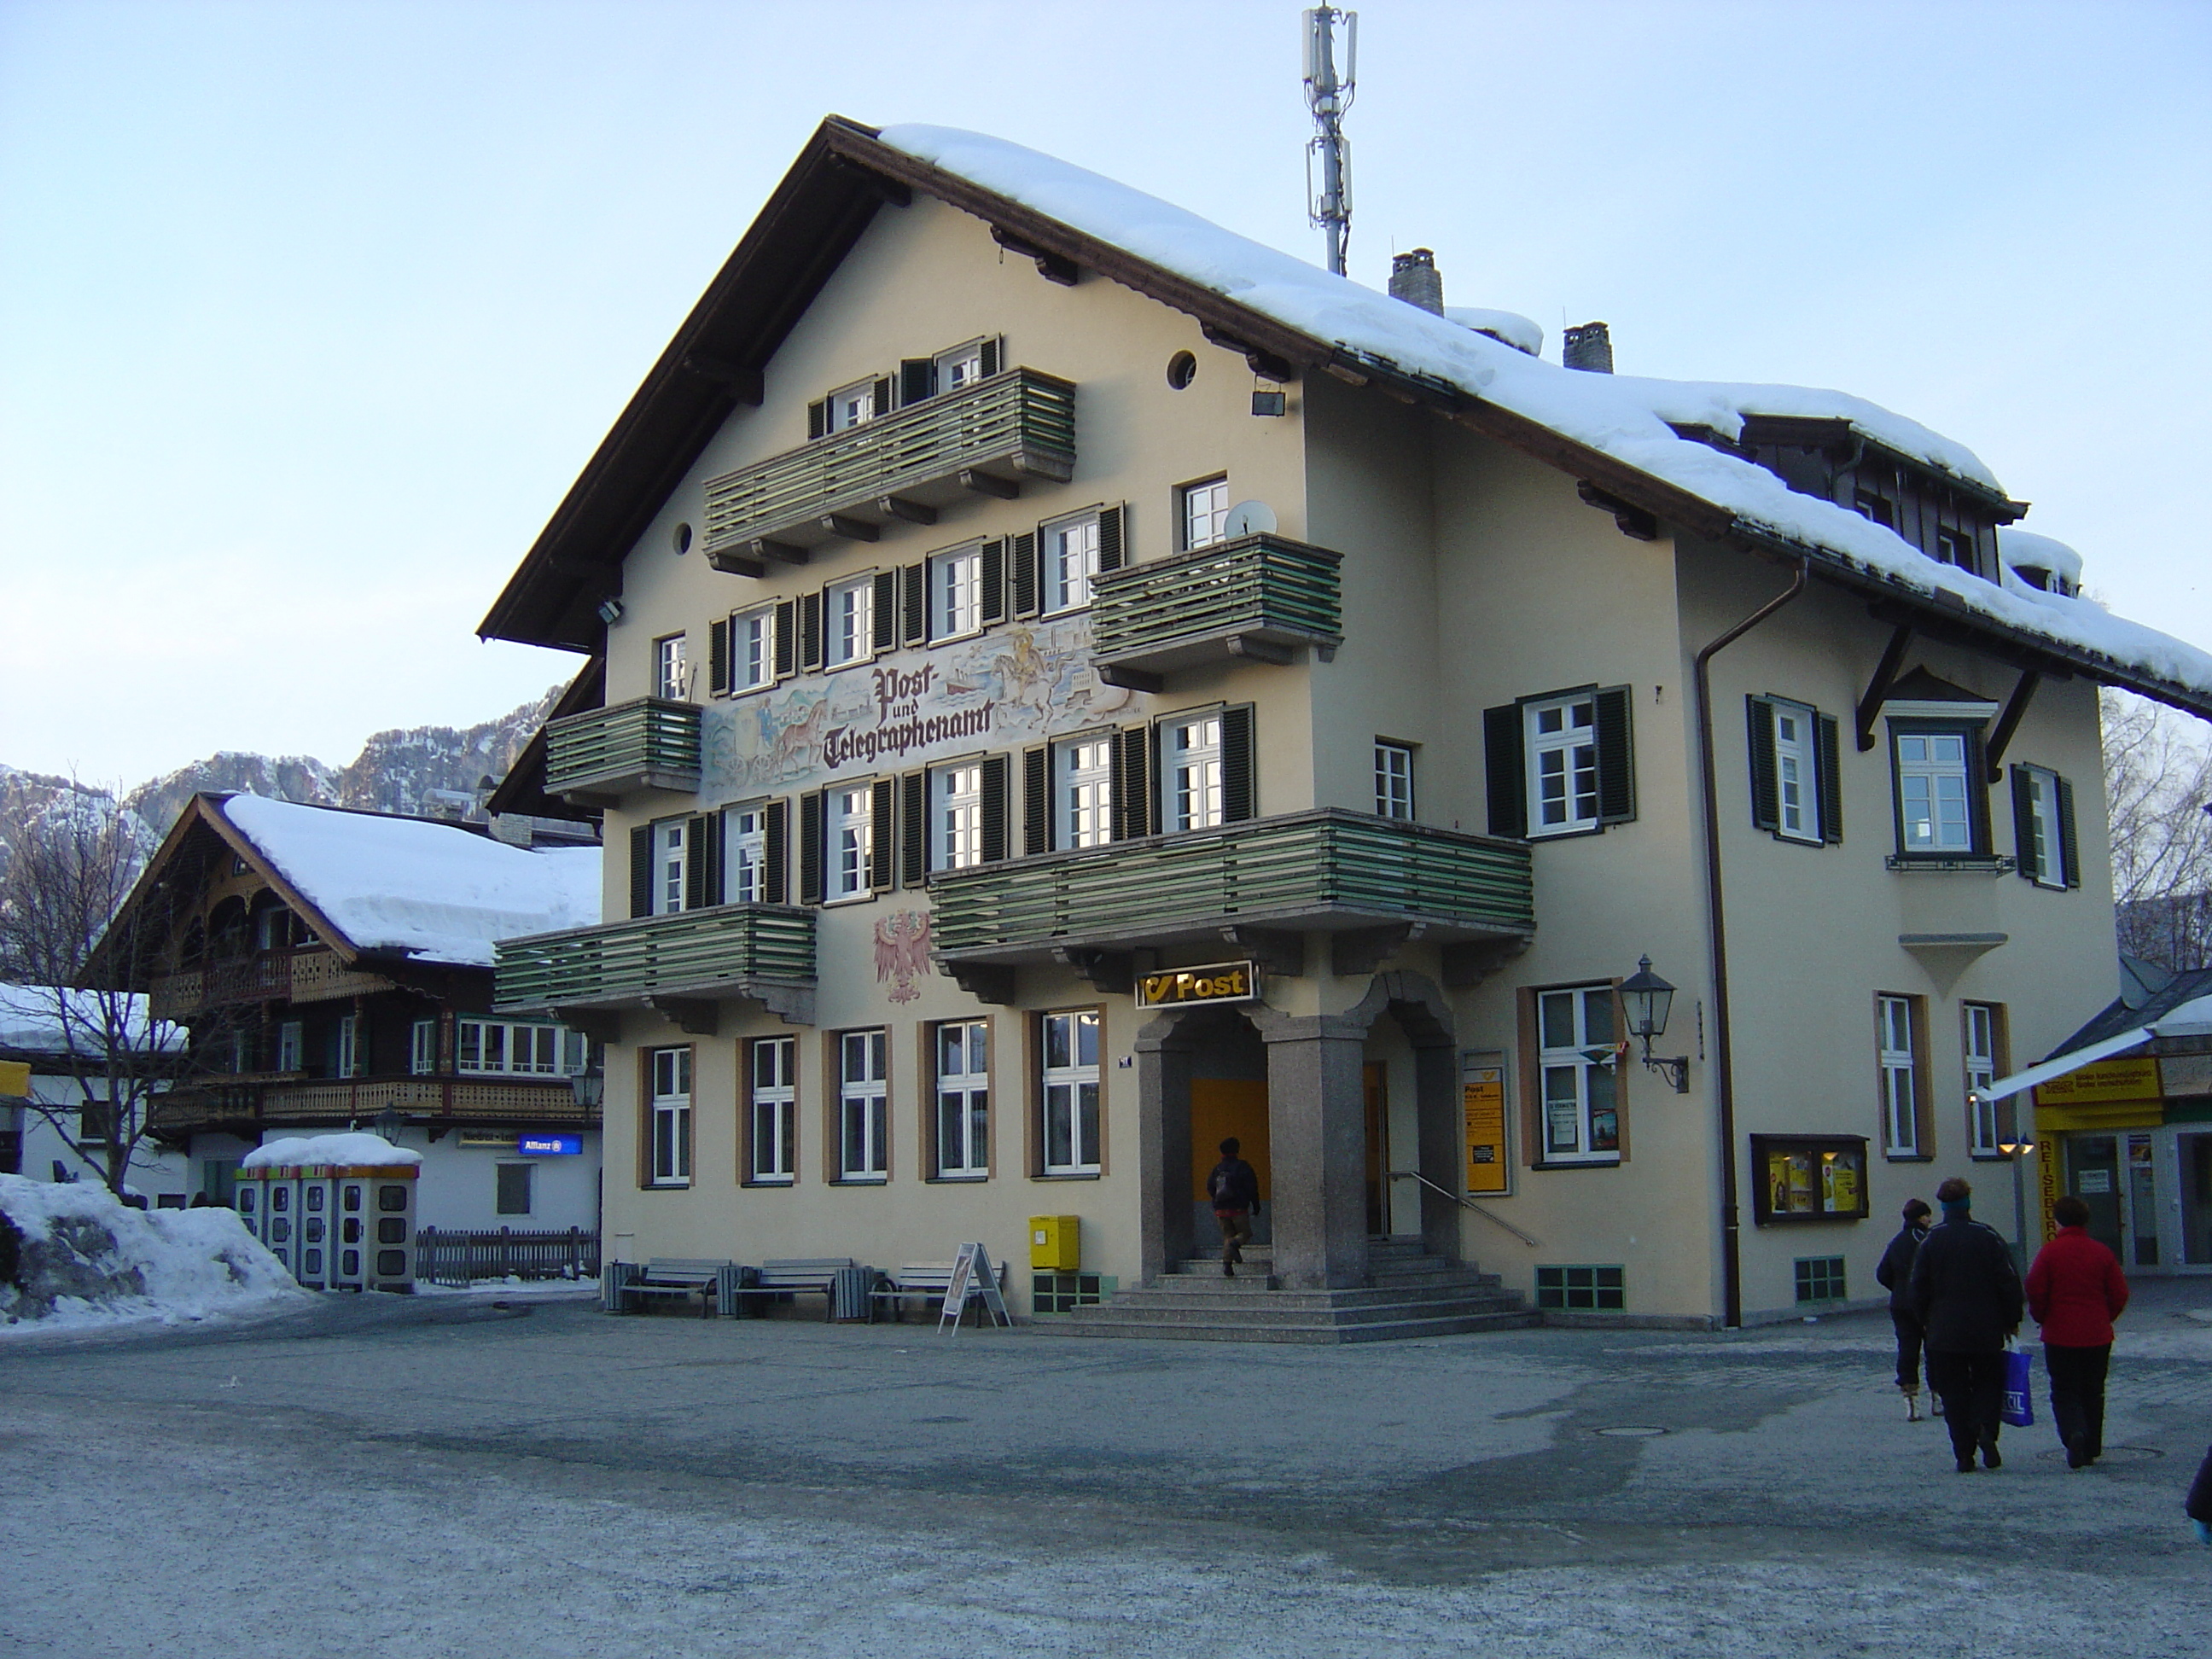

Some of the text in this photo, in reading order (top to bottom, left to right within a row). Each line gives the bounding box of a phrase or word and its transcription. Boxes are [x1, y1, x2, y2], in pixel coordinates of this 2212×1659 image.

[893, 698, 919, 718] und
[824, 697, 995, 769] Telegraphenamt
[1177, 970, 1243, 998] Post
[525, 1140, 551, 1150] Allianz
